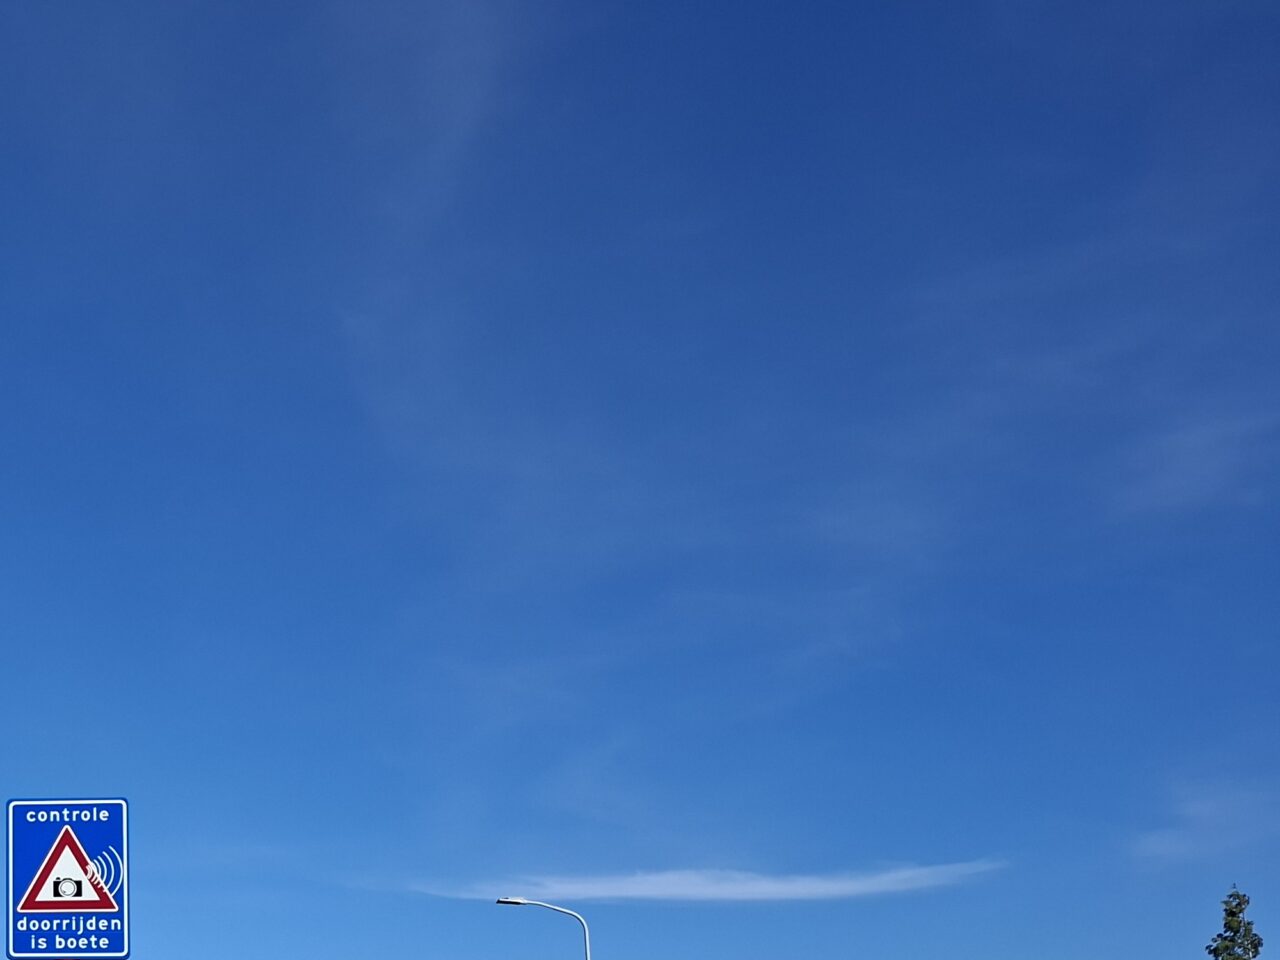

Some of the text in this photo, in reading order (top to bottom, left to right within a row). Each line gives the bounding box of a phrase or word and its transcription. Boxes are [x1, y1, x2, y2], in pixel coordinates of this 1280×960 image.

[26, 807, 110, 822] controle
[17, 916, 121, 935] doorrijden
[31, 934, 110, 949] is boete
